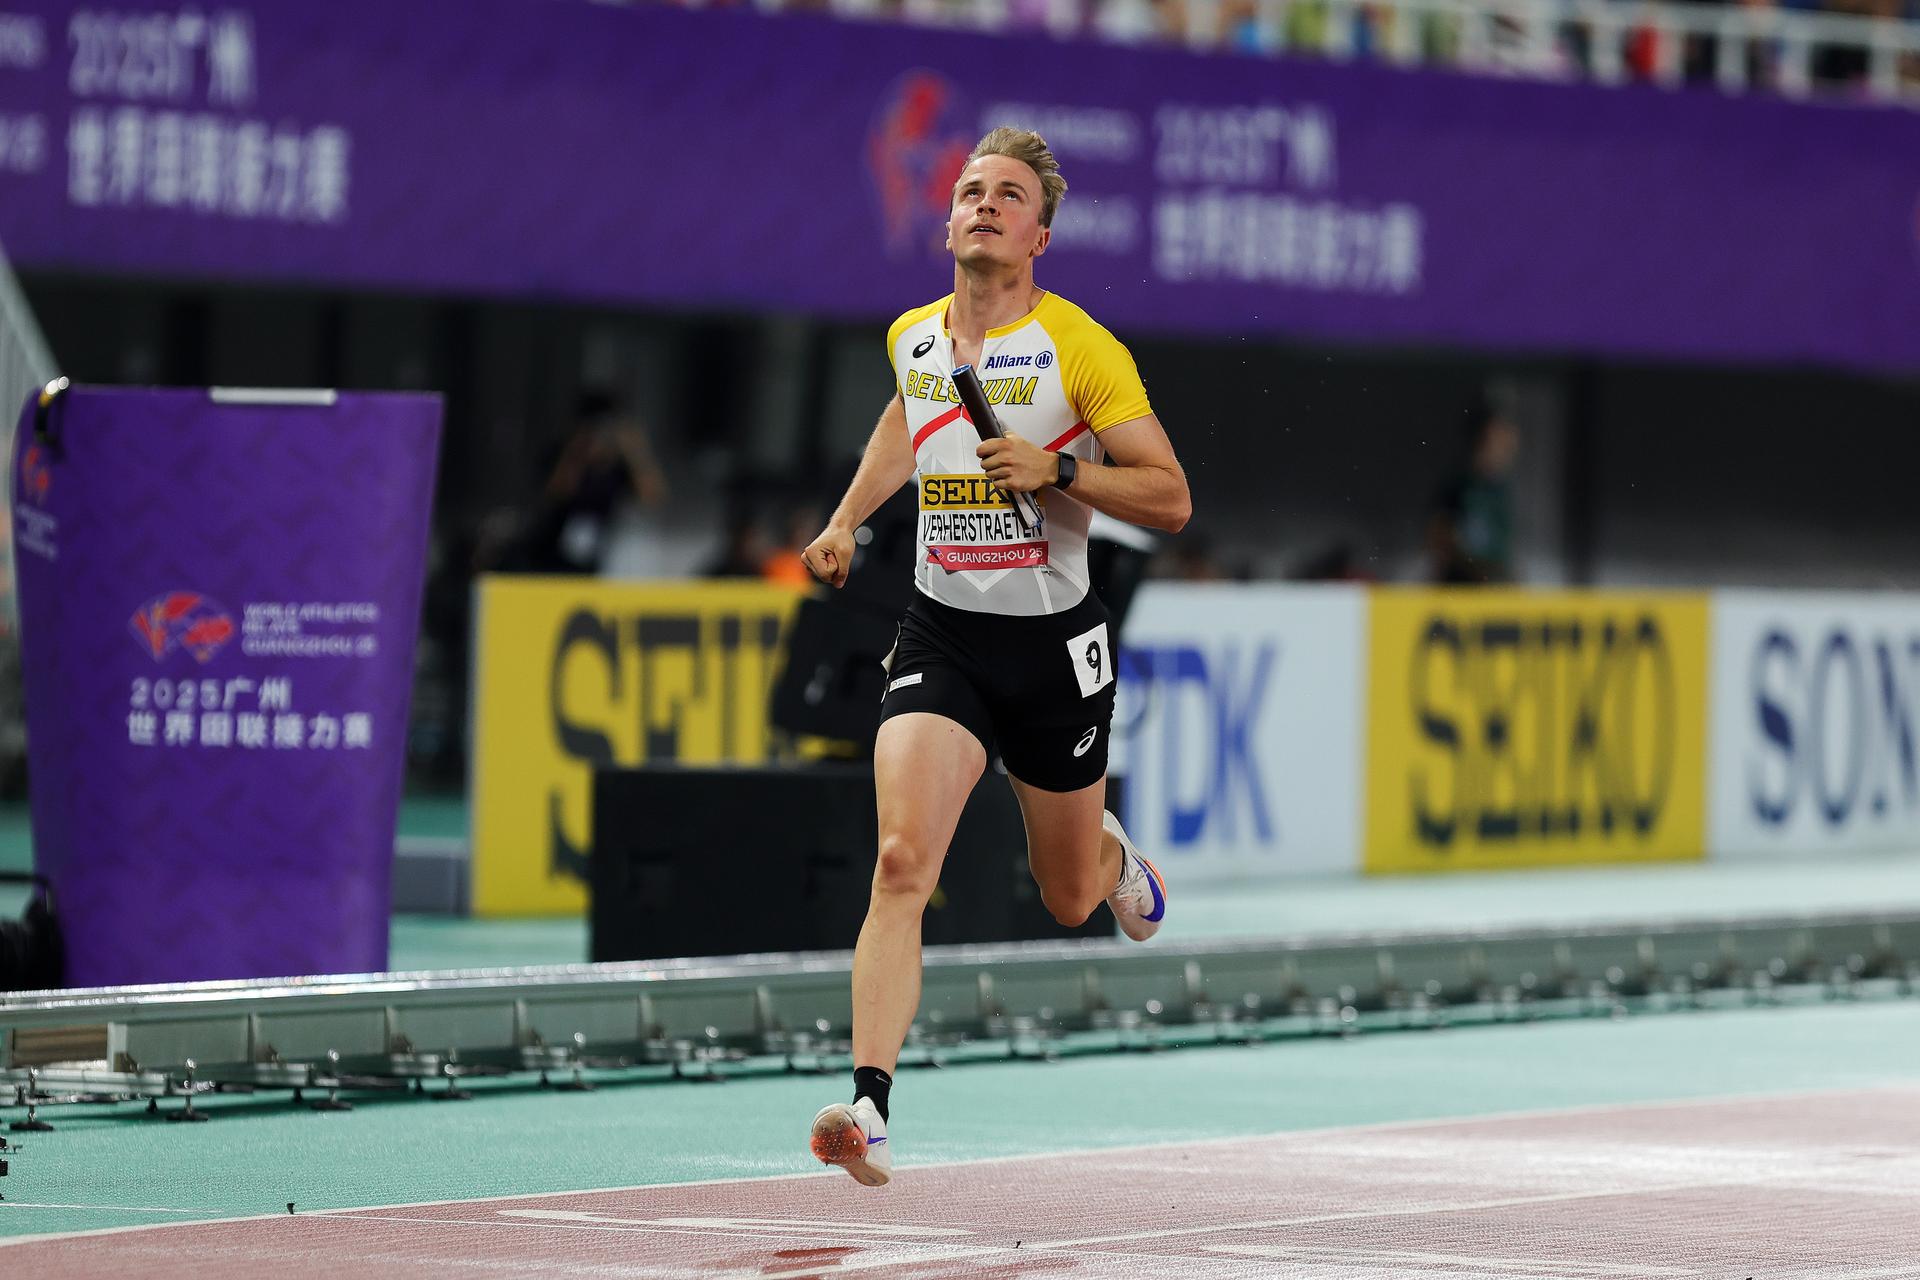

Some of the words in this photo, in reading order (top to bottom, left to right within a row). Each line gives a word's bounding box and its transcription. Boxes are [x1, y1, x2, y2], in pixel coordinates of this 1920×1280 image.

[985, 355, 1032, 369] Allianz
[924, 479, 1010, 506] SEIK
[946, 549, 1025, 563] GUANGZHOU
[1086, 640, 1101, 684] 9
[130, 677, 292, 711] 2025广州
[1409, 614, 1675, 848] SEIKO
